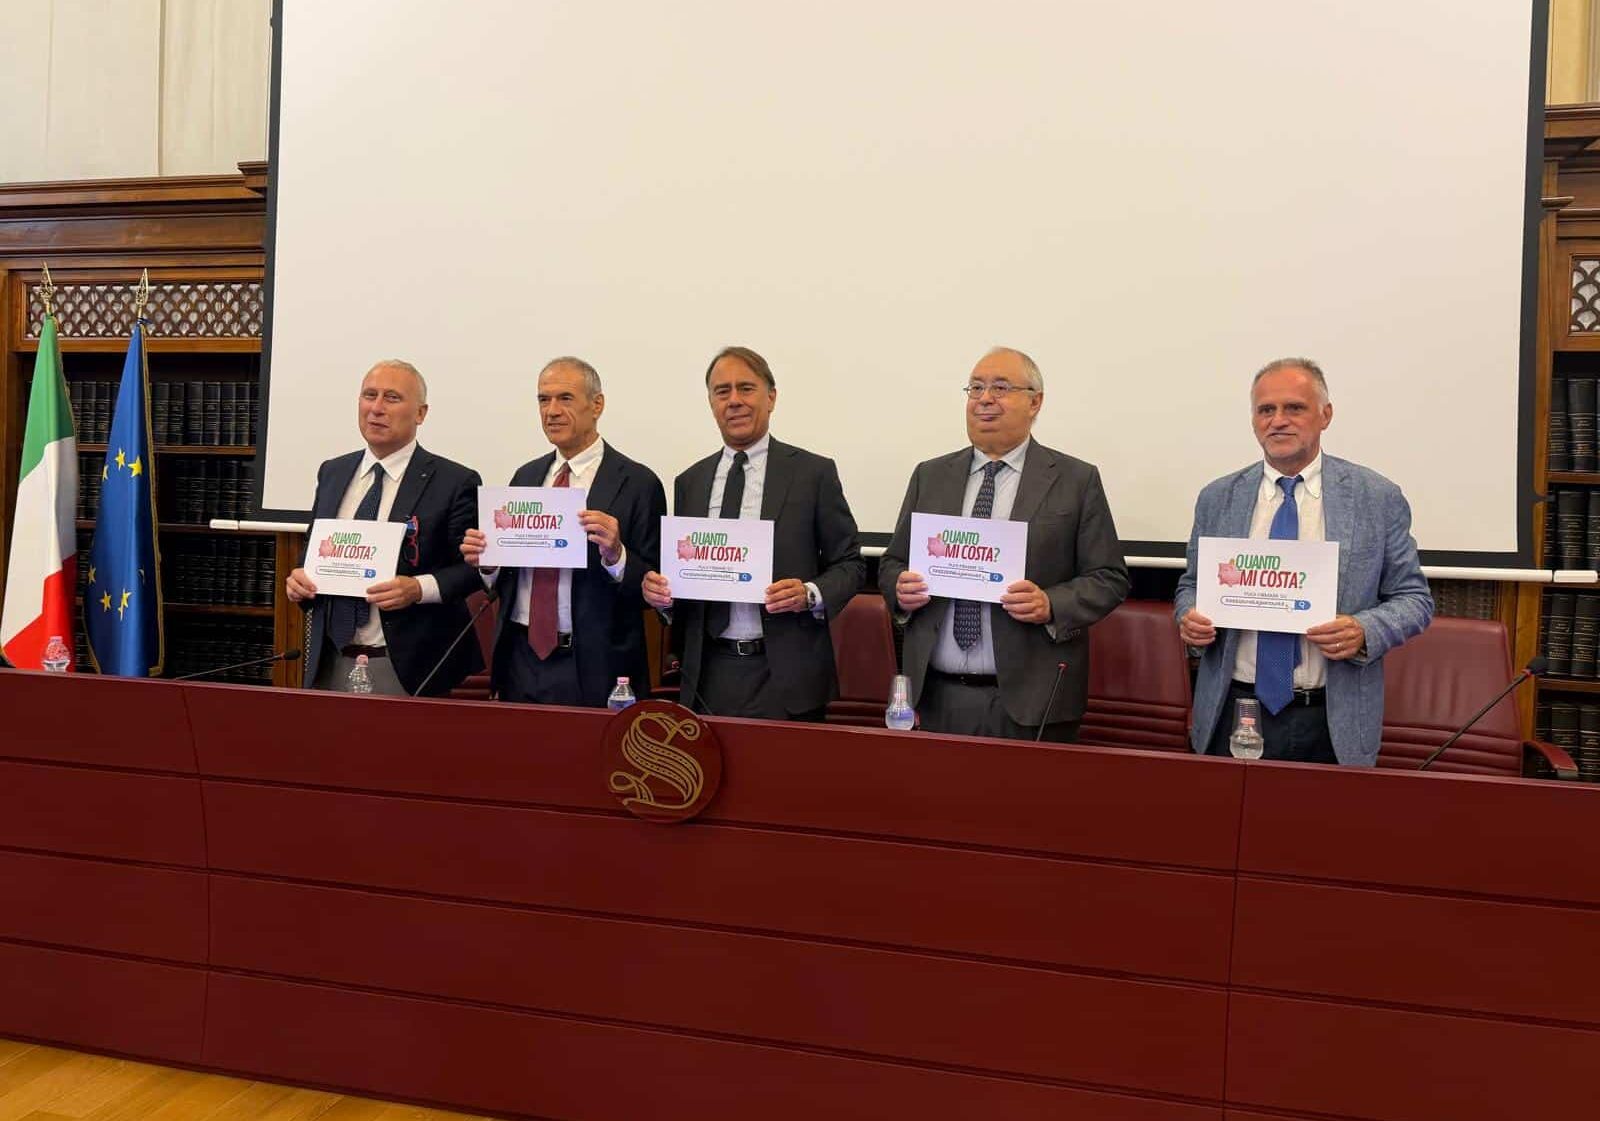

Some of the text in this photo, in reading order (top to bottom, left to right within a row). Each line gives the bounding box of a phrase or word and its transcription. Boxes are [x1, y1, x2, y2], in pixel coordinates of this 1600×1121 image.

[507, 501, 543, 516] QUANTO
[511, 515, 564, 530] MI COSTA?
[691, 532, 728, 547] QUANTO
[942, 529, 980, 546] QUANTO
[694, 546, 749, 562] MI COSTA?
[944, 544, 1001, 563] MI COSTA?
[1235, 554, 1281, 571] QUANTO
[1240, 569, 1307, 588] MI COSTA?
